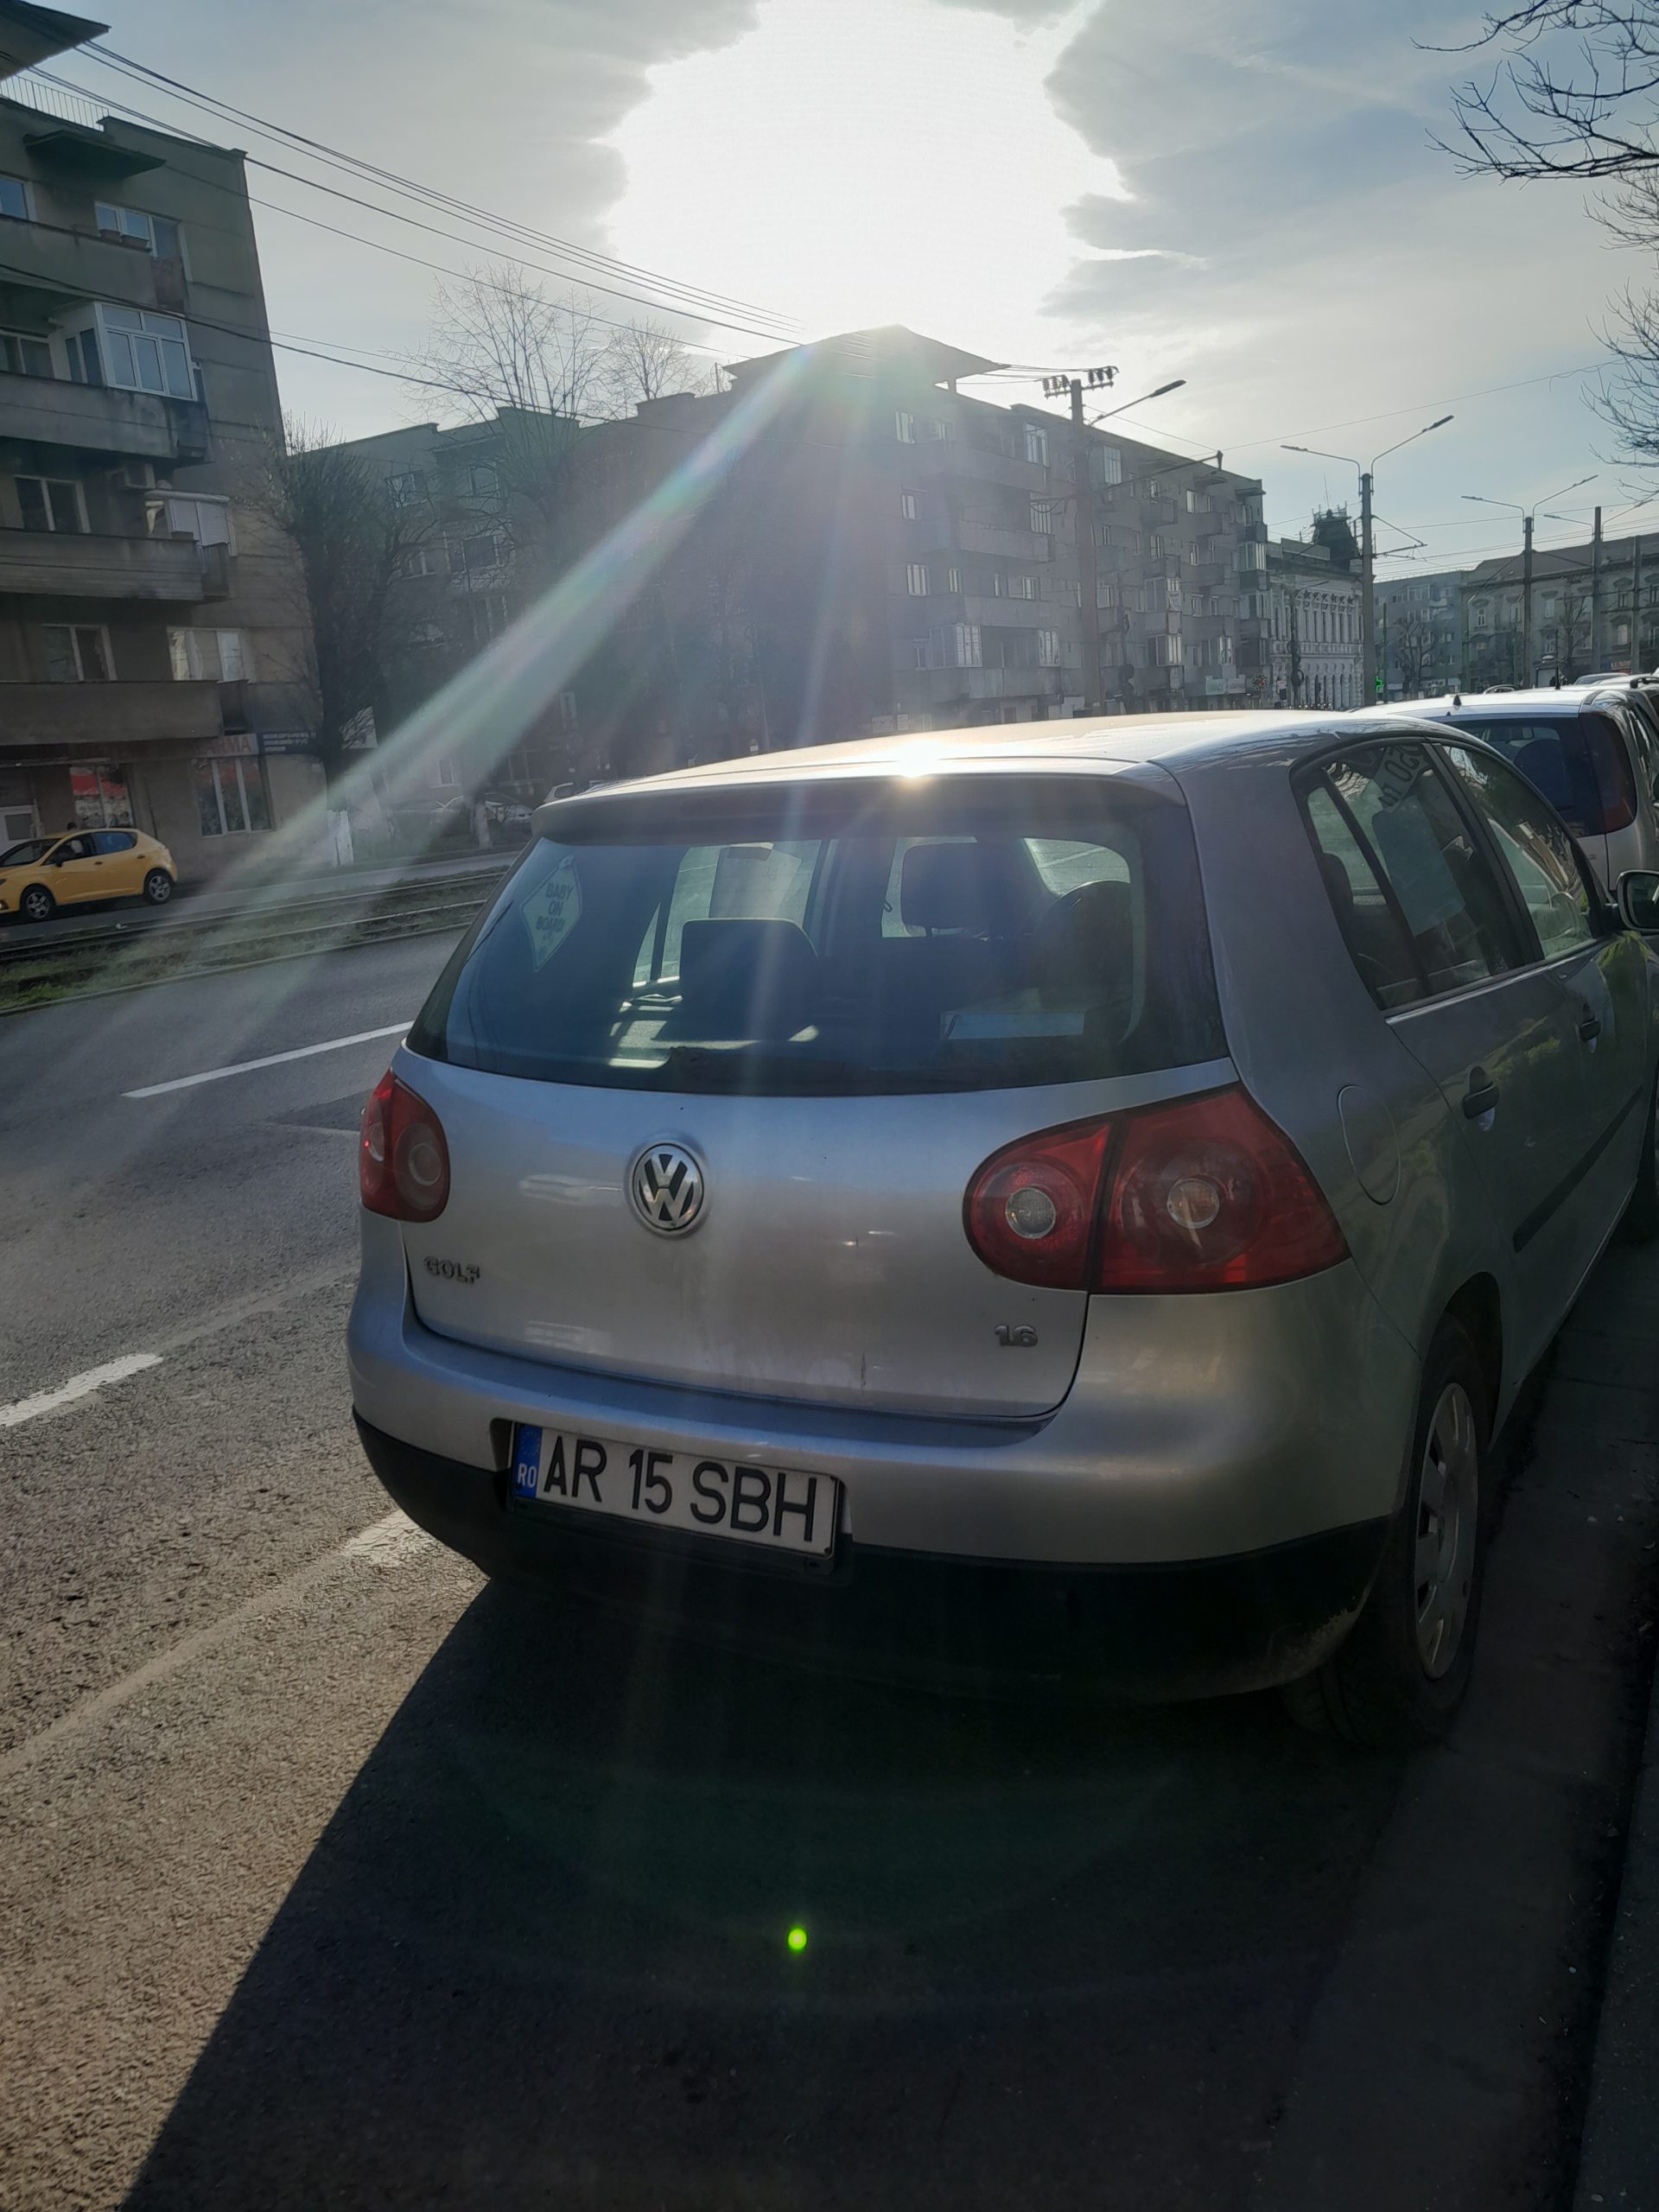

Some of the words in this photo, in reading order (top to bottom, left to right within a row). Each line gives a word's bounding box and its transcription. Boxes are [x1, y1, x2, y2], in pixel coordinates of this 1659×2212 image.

[546, 883, 575, 900] BABY
[549, 899, 564, 916] ON
[518, 1463, 537, 1488] RO
[543, 1436, 607, 1502] AR
[629, 1449, 673, 1514] 15
[690, 1461, 817, 1541] SBH
